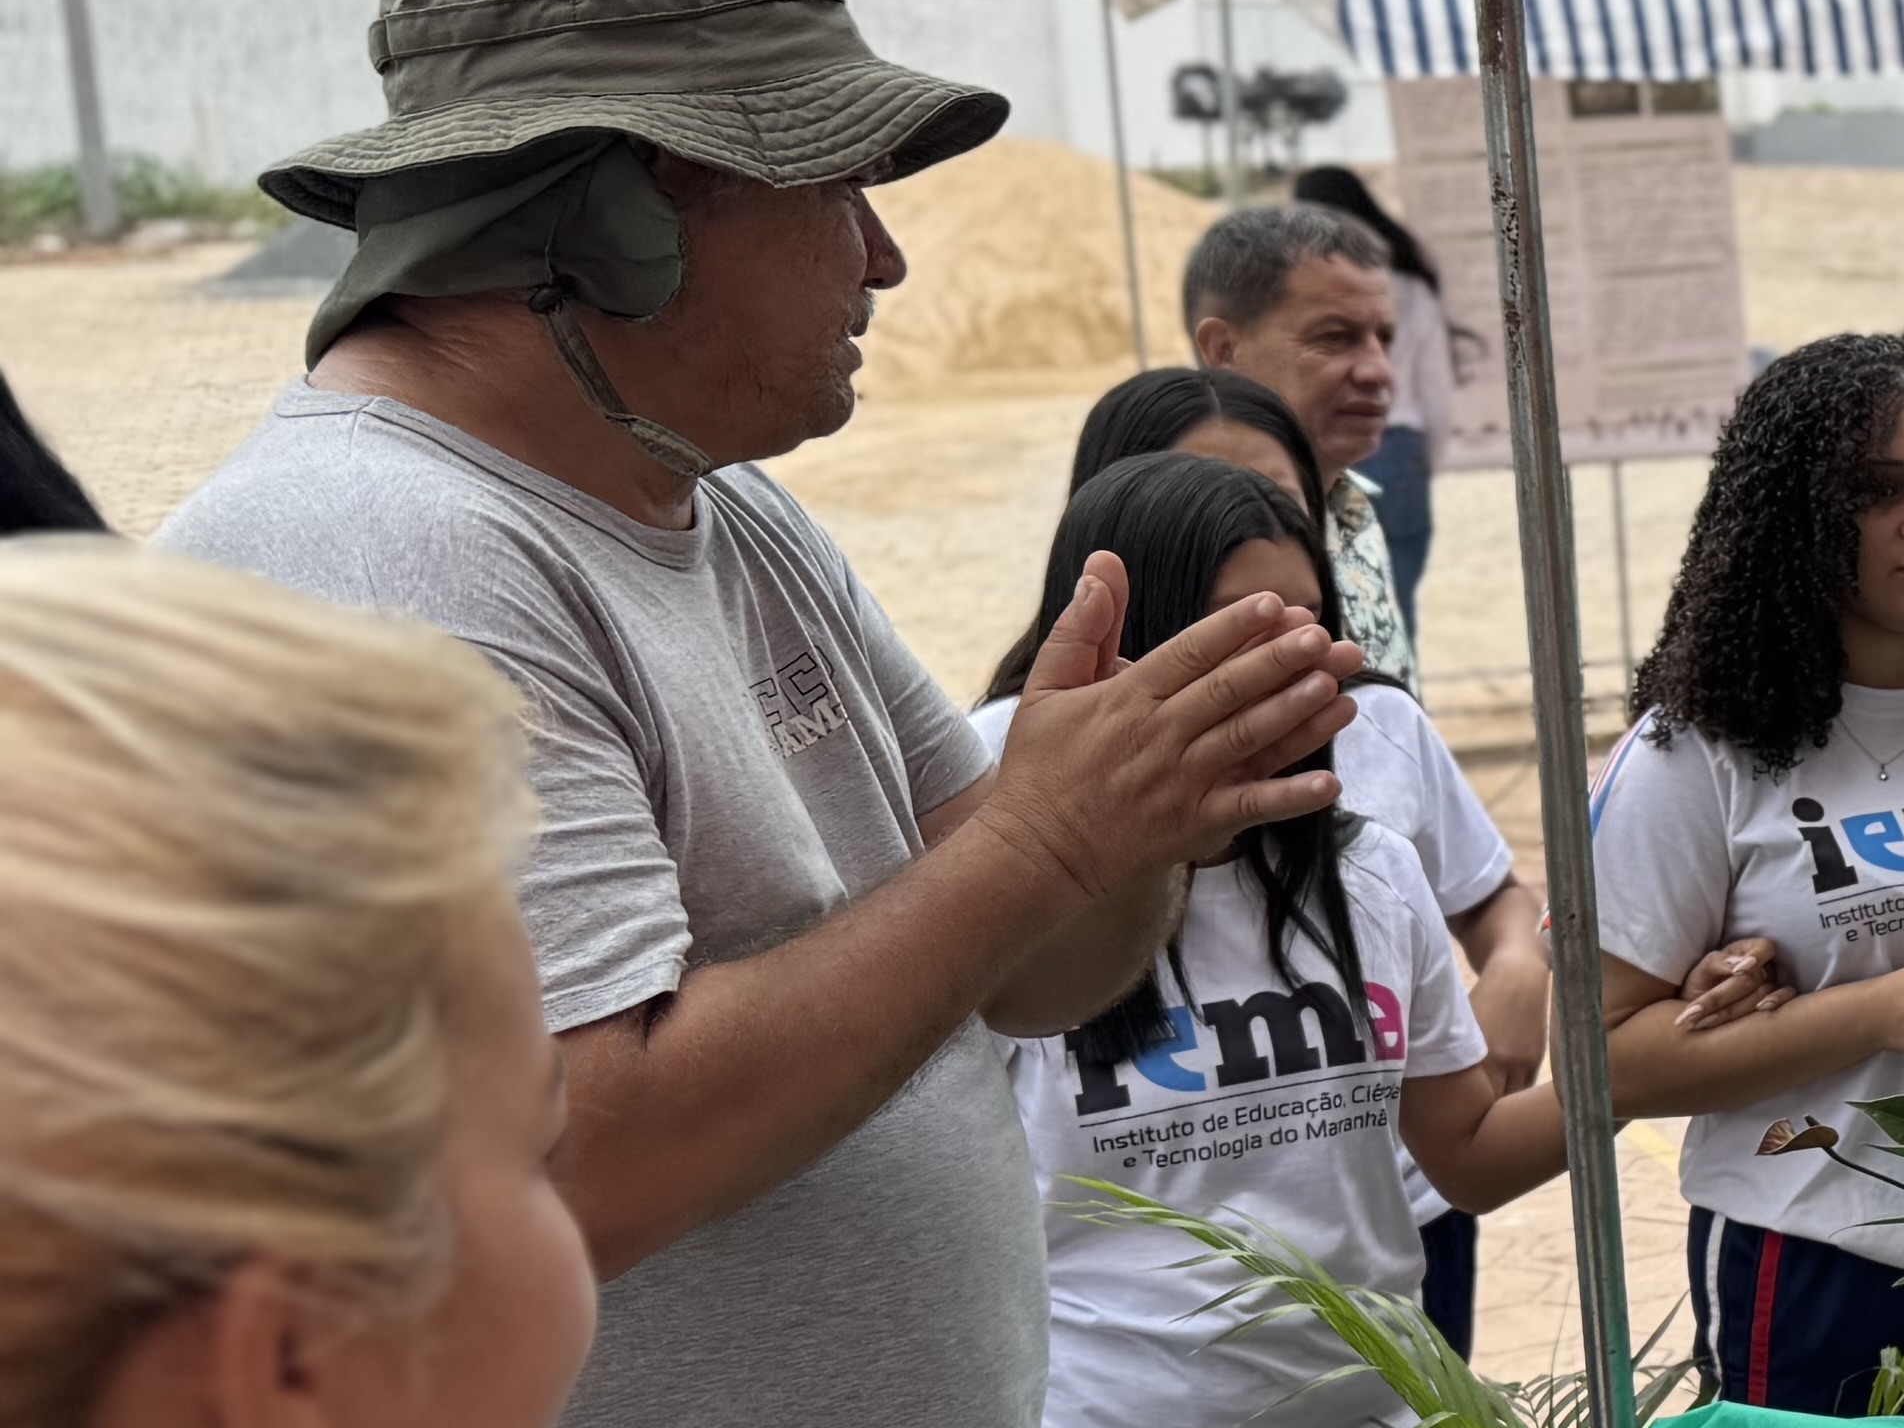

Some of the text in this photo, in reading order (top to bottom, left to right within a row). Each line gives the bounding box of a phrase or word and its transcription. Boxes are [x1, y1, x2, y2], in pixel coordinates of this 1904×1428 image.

[1845, 928, 1859, 943] e
[1093, 1119, 1195, 1154] Instituto
[1203, 1113, 1228, 1134] de
[1235, 1091, 1346, 1129] Educação,
[1123, 1155, 1137, 1169] e
[1143, 1133, 1263, 1169] Tecnologia
[1270, 1125, 1298, 1146] do
